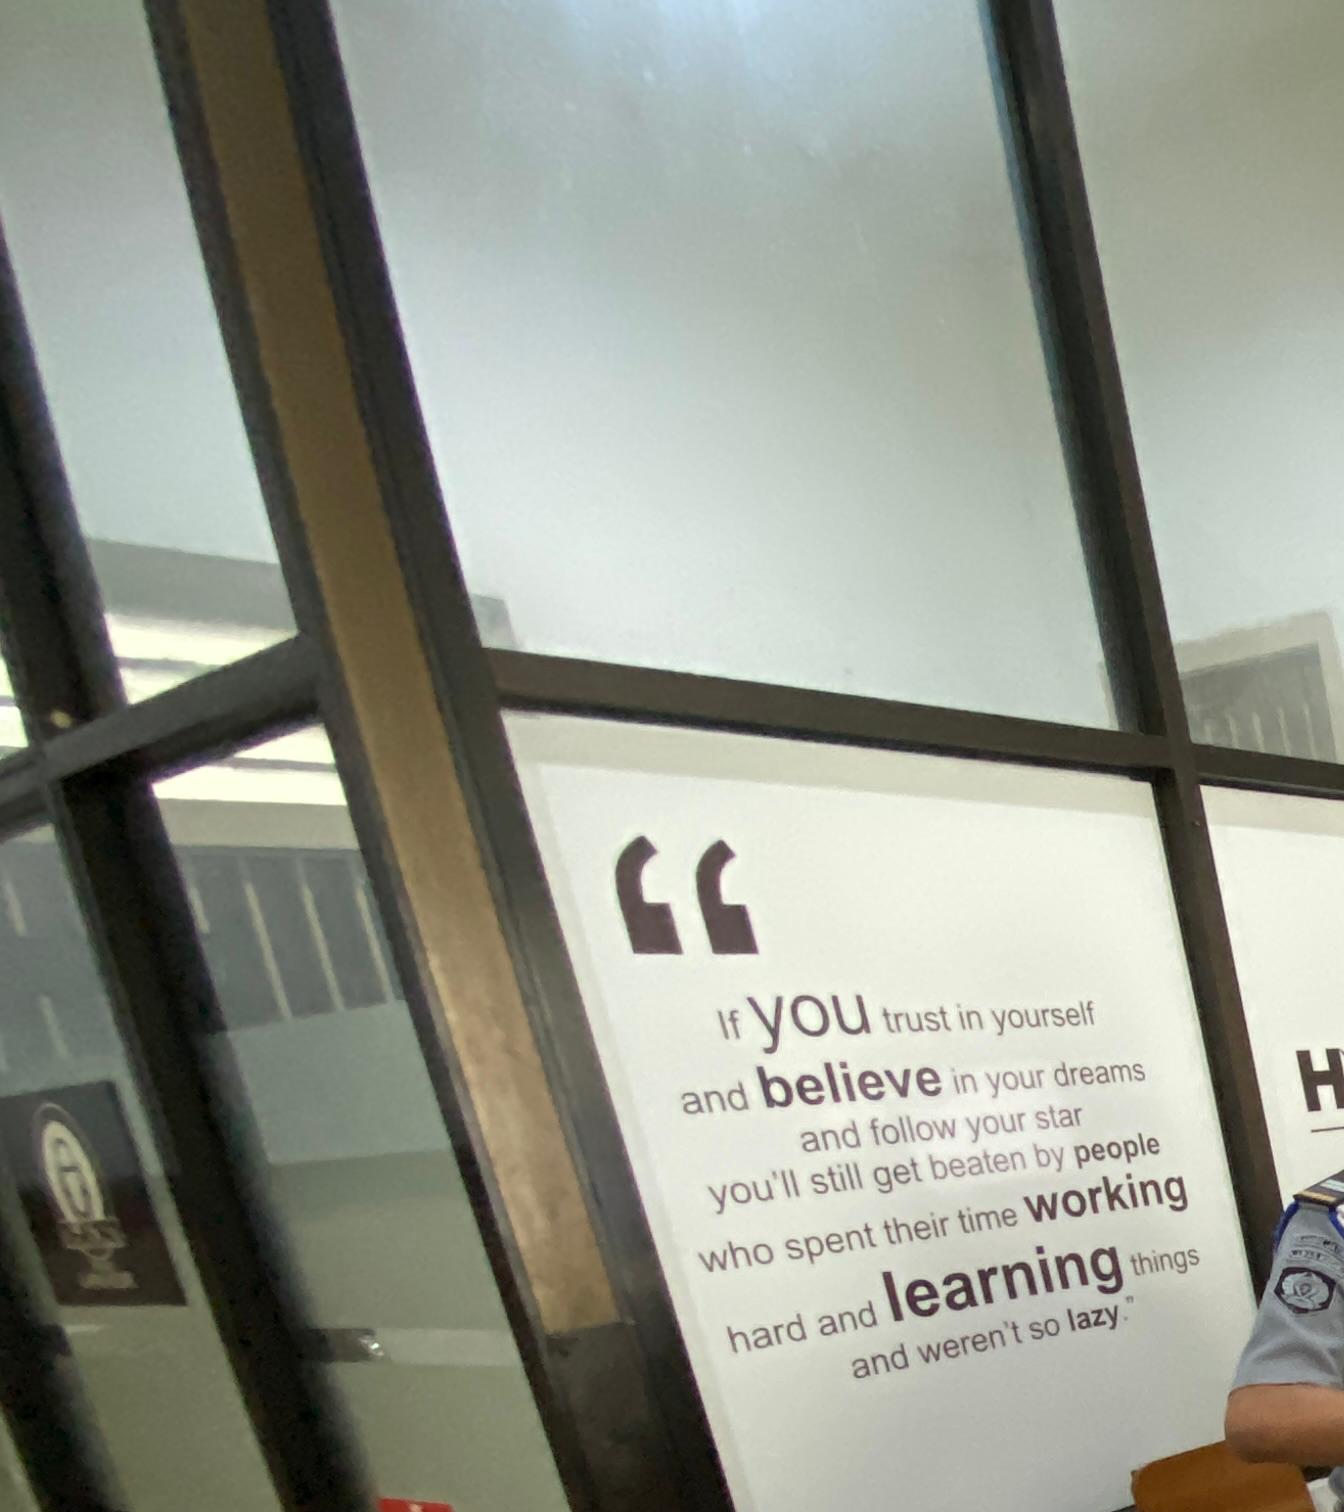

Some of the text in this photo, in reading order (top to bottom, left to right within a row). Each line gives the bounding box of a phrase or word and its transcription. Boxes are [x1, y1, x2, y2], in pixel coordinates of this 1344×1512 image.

[716, 993, 1095, 1055] If you trust in yourself
[680, 1060, 1146, 1116] and believe in your dreams
[799, 1105, 1083, 1153] and follow your star
[707, 1132, 1161, 1216] you'll still get beaten by people
[697, 1172, 1189, 1273] who spent their time working
[725, 1245, 1201, 1354] hard and learning things
[851, 1342, 910, 1380] and
[916, 1320, 1024, 1364] weren't
[1028, 1318, 1061, 1341] so
